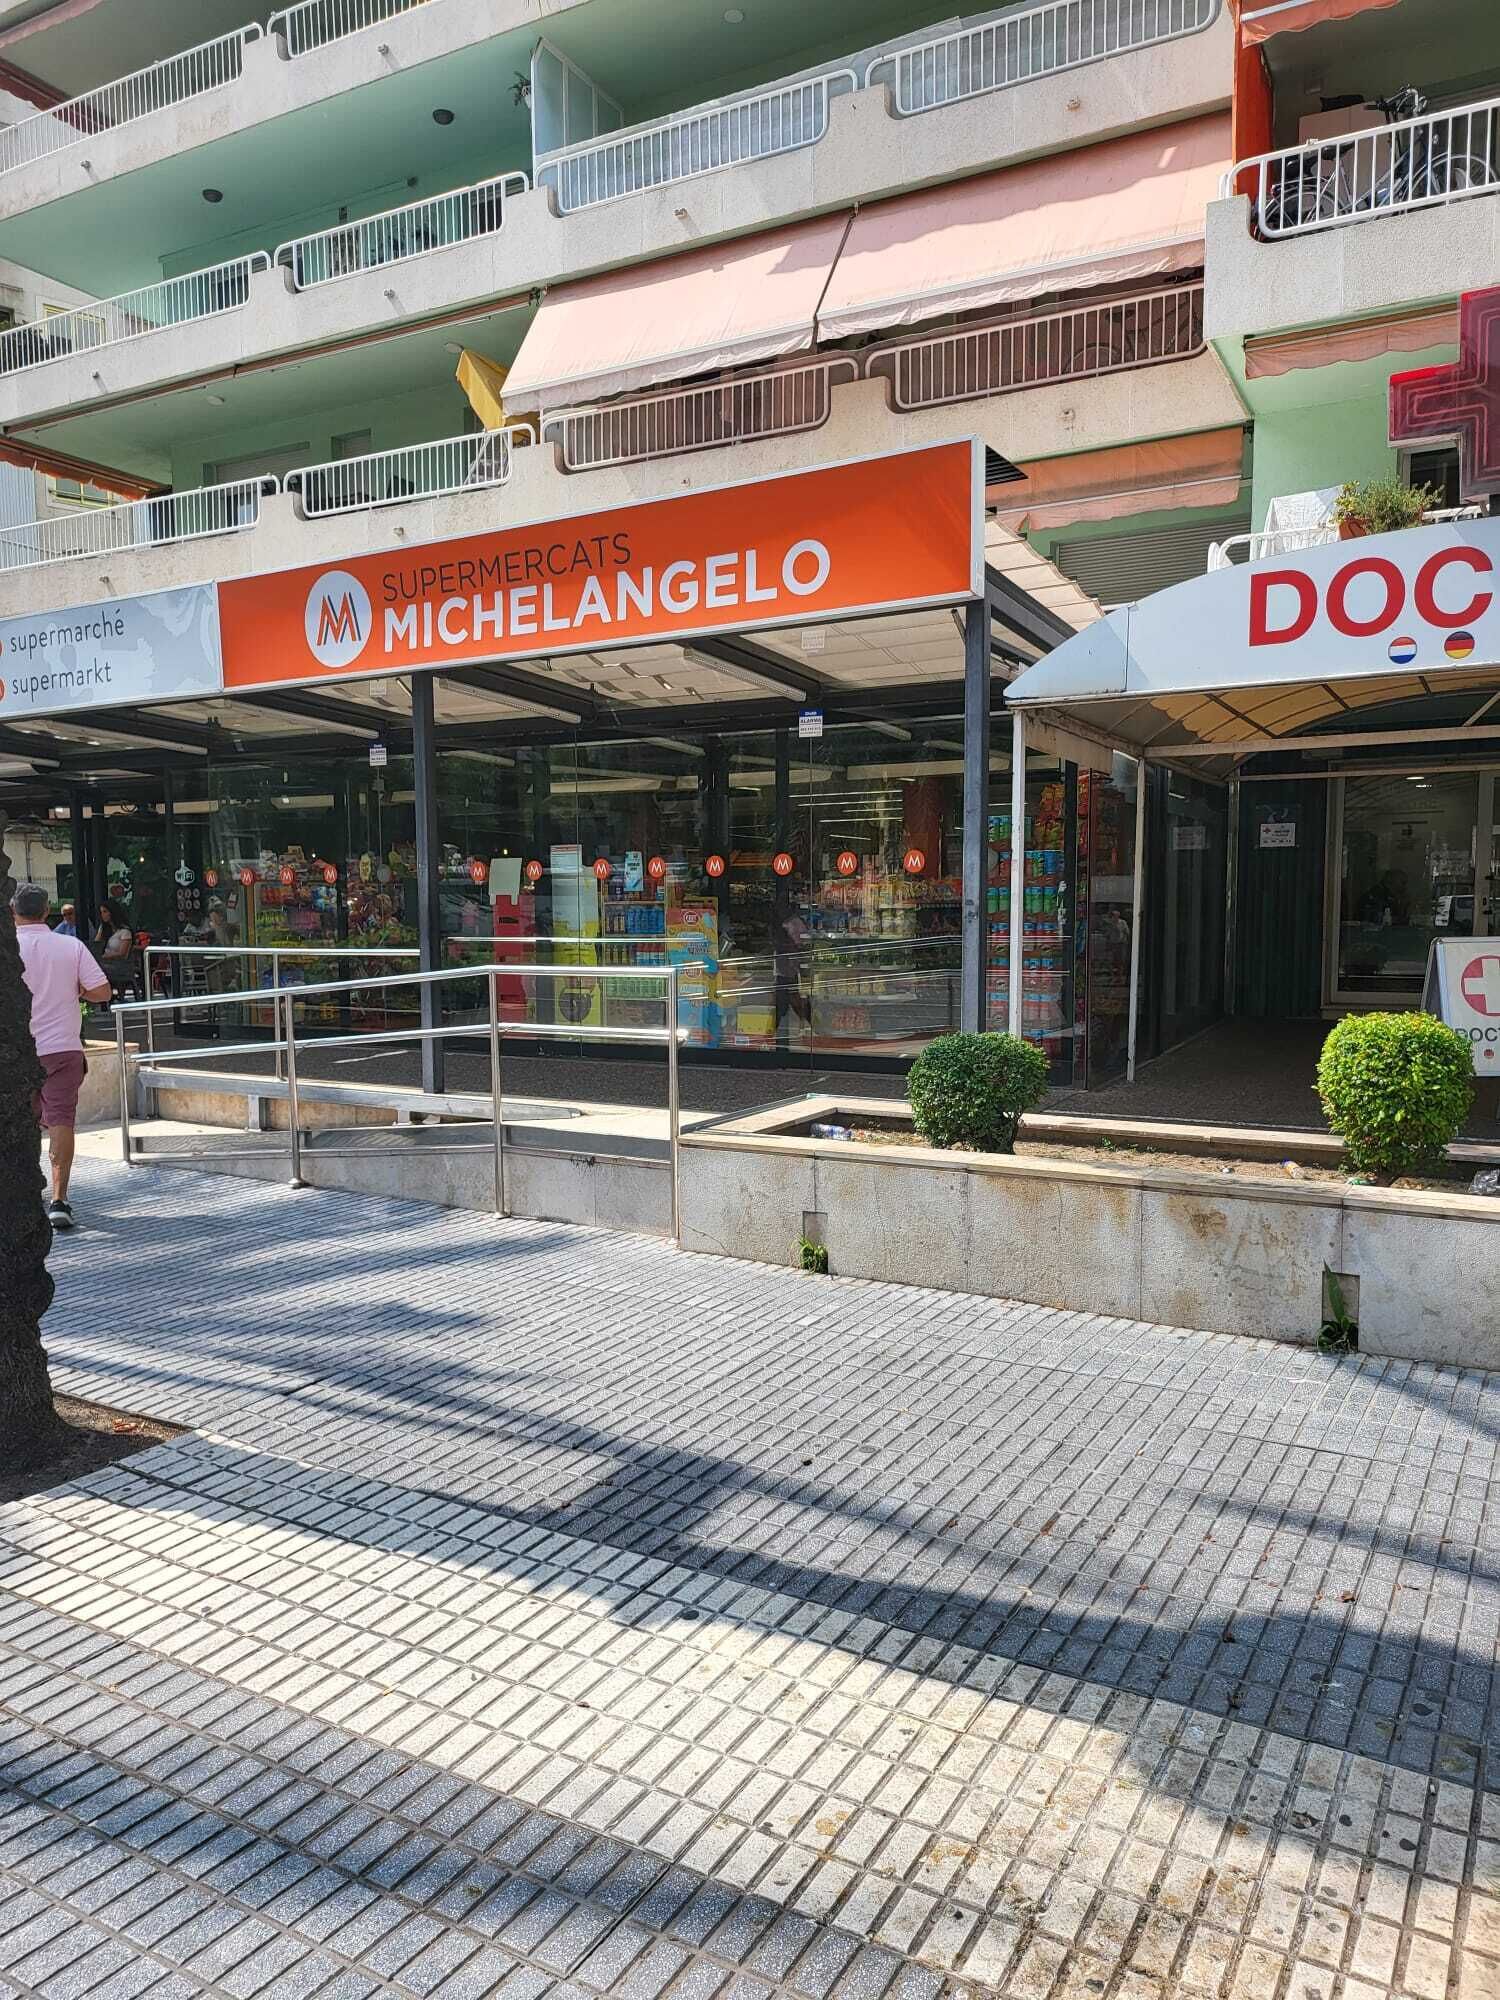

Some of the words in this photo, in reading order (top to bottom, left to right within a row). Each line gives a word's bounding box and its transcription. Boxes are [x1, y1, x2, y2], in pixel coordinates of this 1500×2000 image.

[383, 533, 631, 602] SUPERMERCATS
[316, 592, 362, 646] M
[384, 539, 831, 653] MICHELANGELO
[1248, 546, 1493, 647] DOC
[10, 608, 125, 659] supermarché
[12, 657, 112, 702] supermarkt
[1455, 1027, 1500, 1042] DOC
